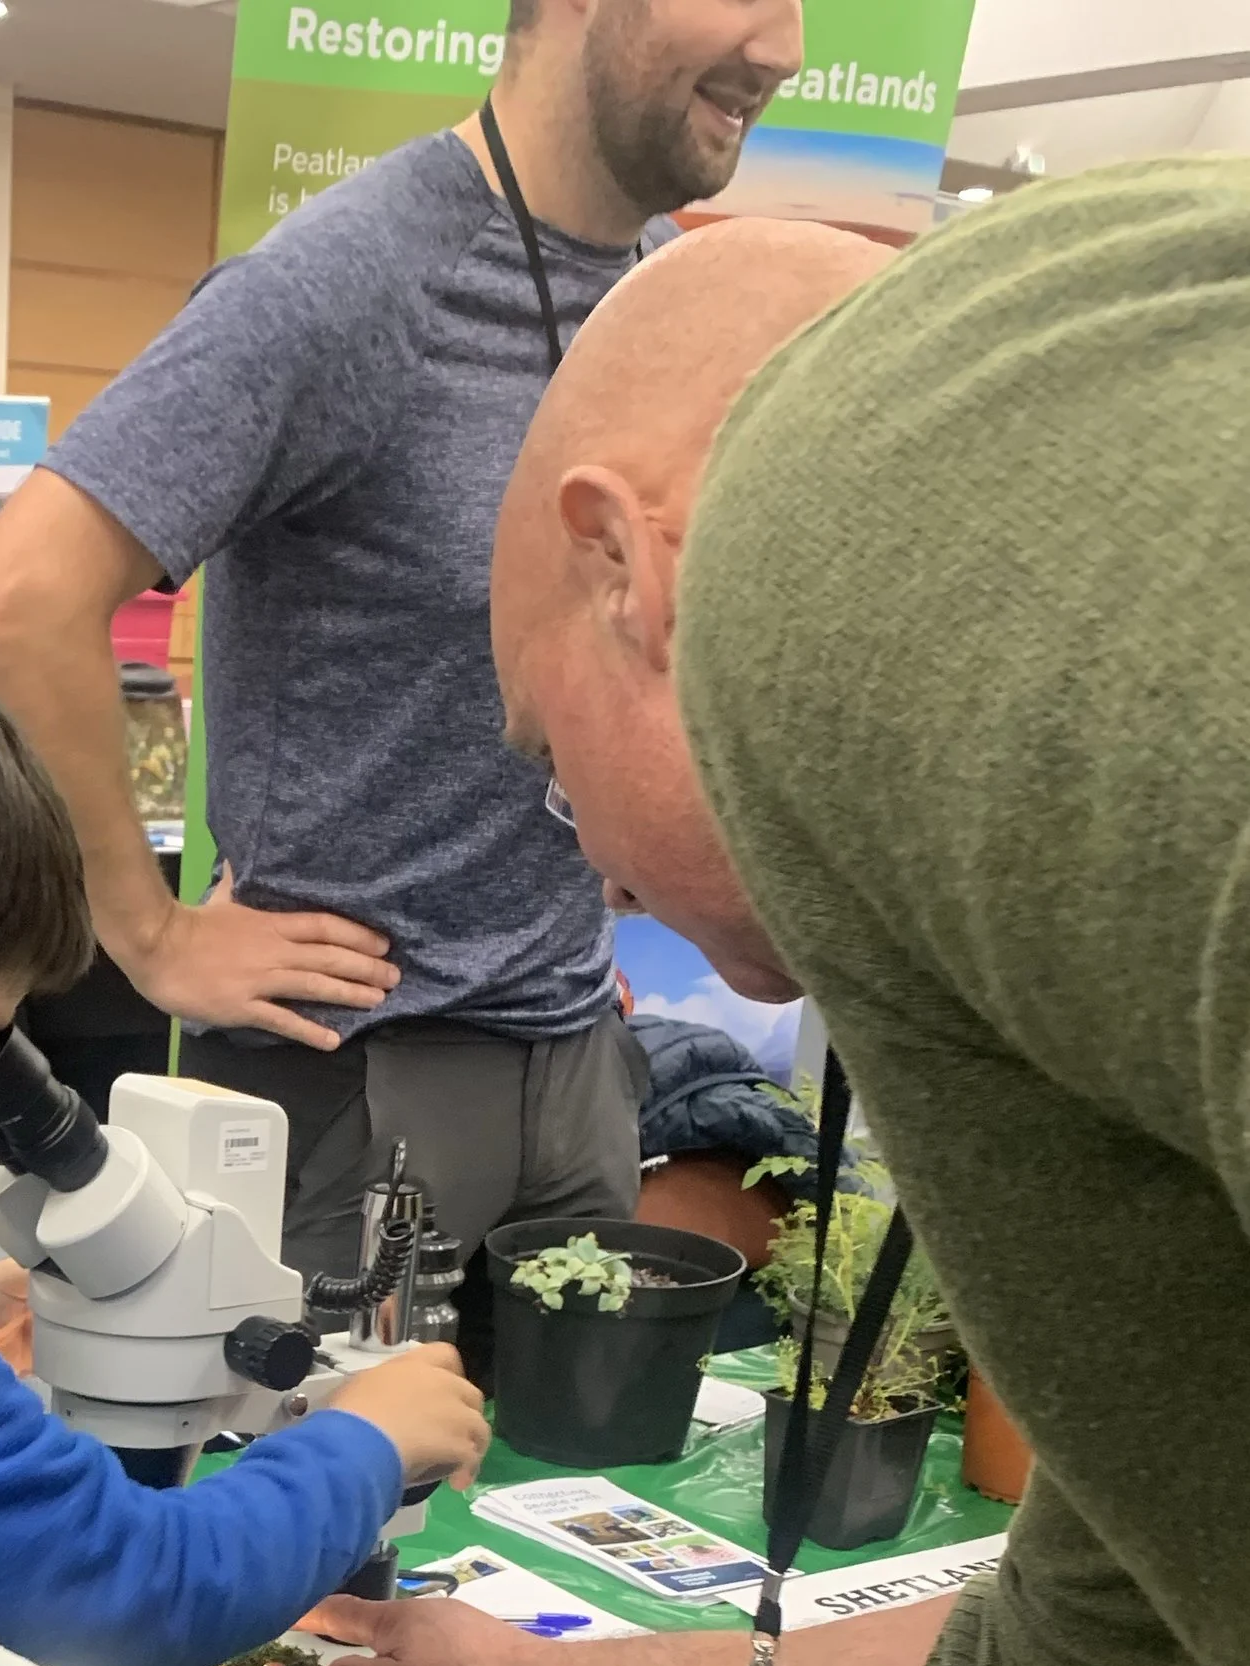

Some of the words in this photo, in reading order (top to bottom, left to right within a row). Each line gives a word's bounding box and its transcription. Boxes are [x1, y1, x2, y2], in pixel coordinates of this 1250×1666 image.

[287, 7, 505, 76] Restoring
[778, 61, 937, 114] eatlands
[269, 185, 289, 215] is
